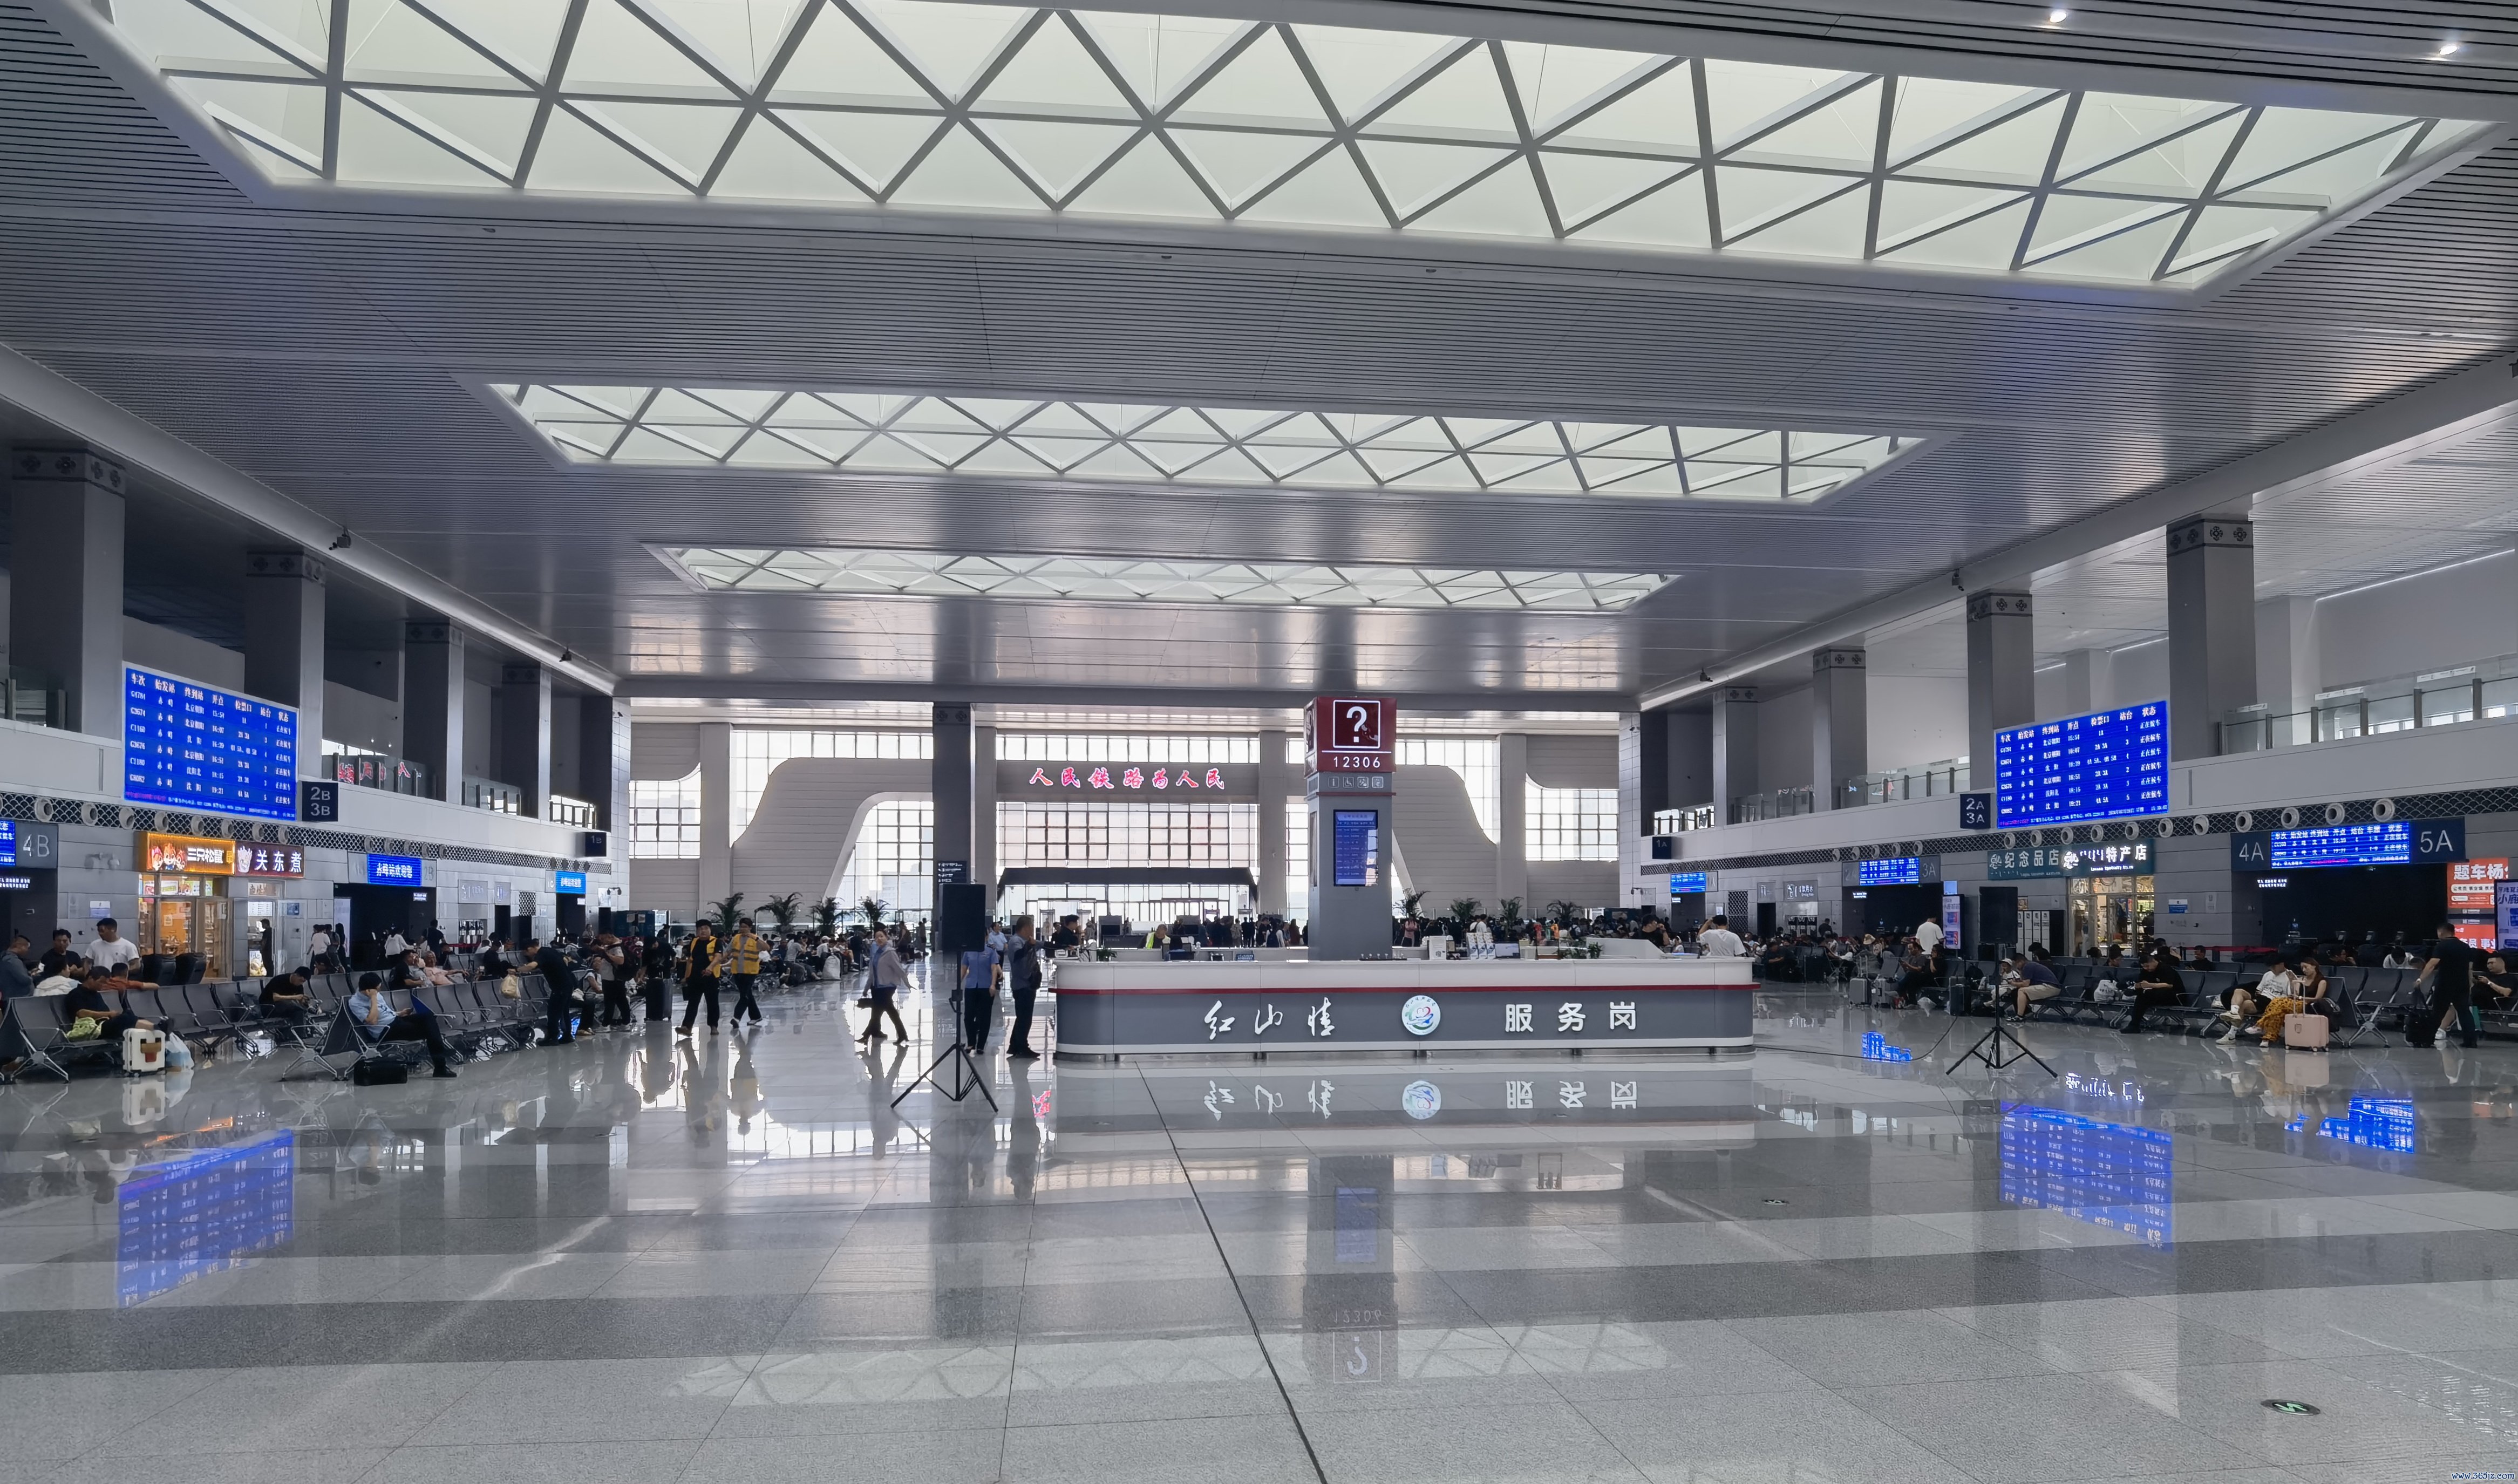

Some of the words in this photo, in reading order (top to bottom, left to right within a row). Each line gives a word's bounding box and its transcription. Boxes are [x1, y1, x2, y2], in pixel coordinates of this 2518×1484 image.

[131, 673, 145, 686] 车次
[155, 679, 175, 693] 始发站
[185, 687, 203, 700] 终到站
[212, 694, 224, 706] 开点
[235, 700, 252, 712] 检票口
[260, 707, 271, 718] 站台
[278, 711, 289, 722] 状态
[2000, 734, 2011, 743] 车次
[2018, 730, 2034, 740] 始发站
[2042, 725, 2059, 736] 终到站
[2067, 721, 2079, 731] 开点
[2091, 716, 2109, 726] 检票口
[2119, 710, 2133, 721] 站台
[2142, 706, 2156, 717] 状态
[1333, 757, 1380, 768] 12306
[1029, 767, 1225, 789] 人民铁路为人民
[310, 787, 331, 800] 2B
[310, 803, 330, 815] 3B
[1966, 798, 1984, 810] 2A
[1966, 812, 1985, 823] 3A
[23, 834, 50, 857] 4B
[2420, 830, 2453, 853] 5A
[187, 848, 224, 863] 三只松鼠
[255, 849, 302, 873] 关东煮
[2004, 849, 2059, 868] 纪念品店
[2106, 844, 2147, 863] 特产店
[2239, 842, 2264, 862] 4A
[1922, 863, 1936, 877] 3A
[1505, 1000, 1637, 1033] 服务岗
